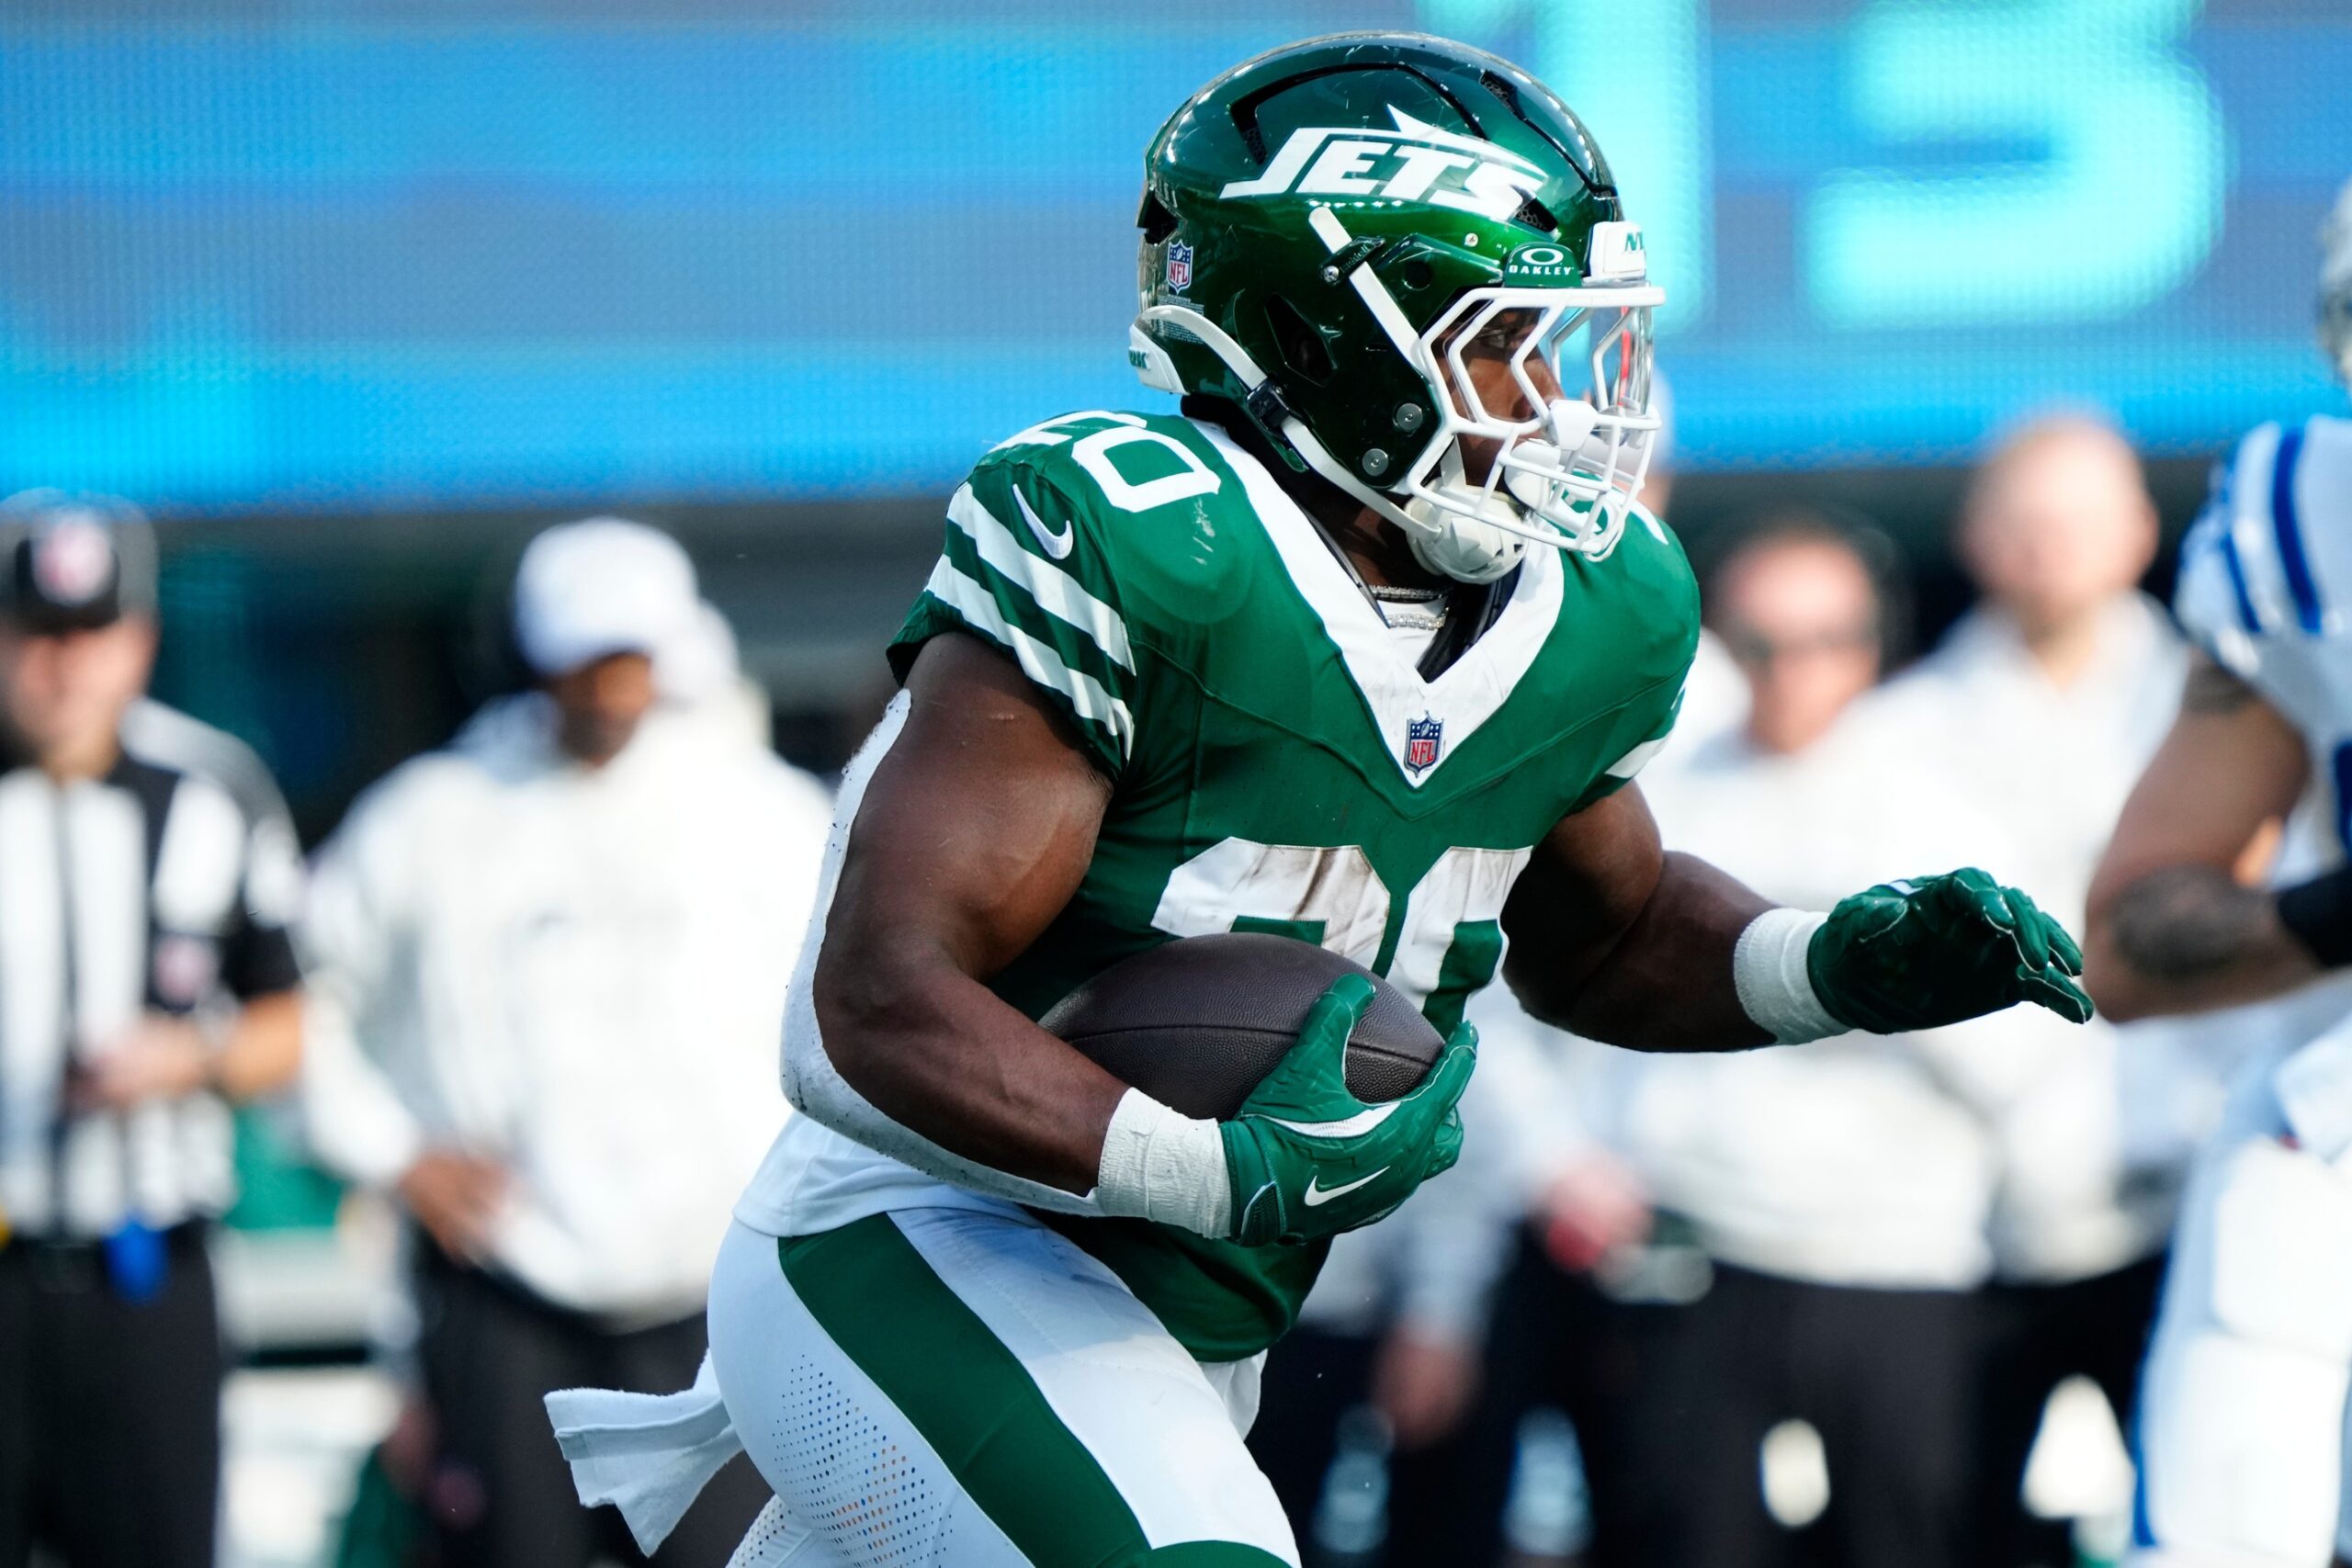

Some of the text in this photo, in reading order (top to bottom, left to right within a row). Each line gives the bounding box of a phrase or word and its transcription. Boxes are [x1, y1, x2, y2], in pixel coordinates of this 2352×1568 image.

[1219, 127, 1547, 221] JETS
[1169, 262, 1188, 282] NFL
[1509, 265, 1572, 276] OAKLEY
[1409, 740, 1434, 765] NFL
